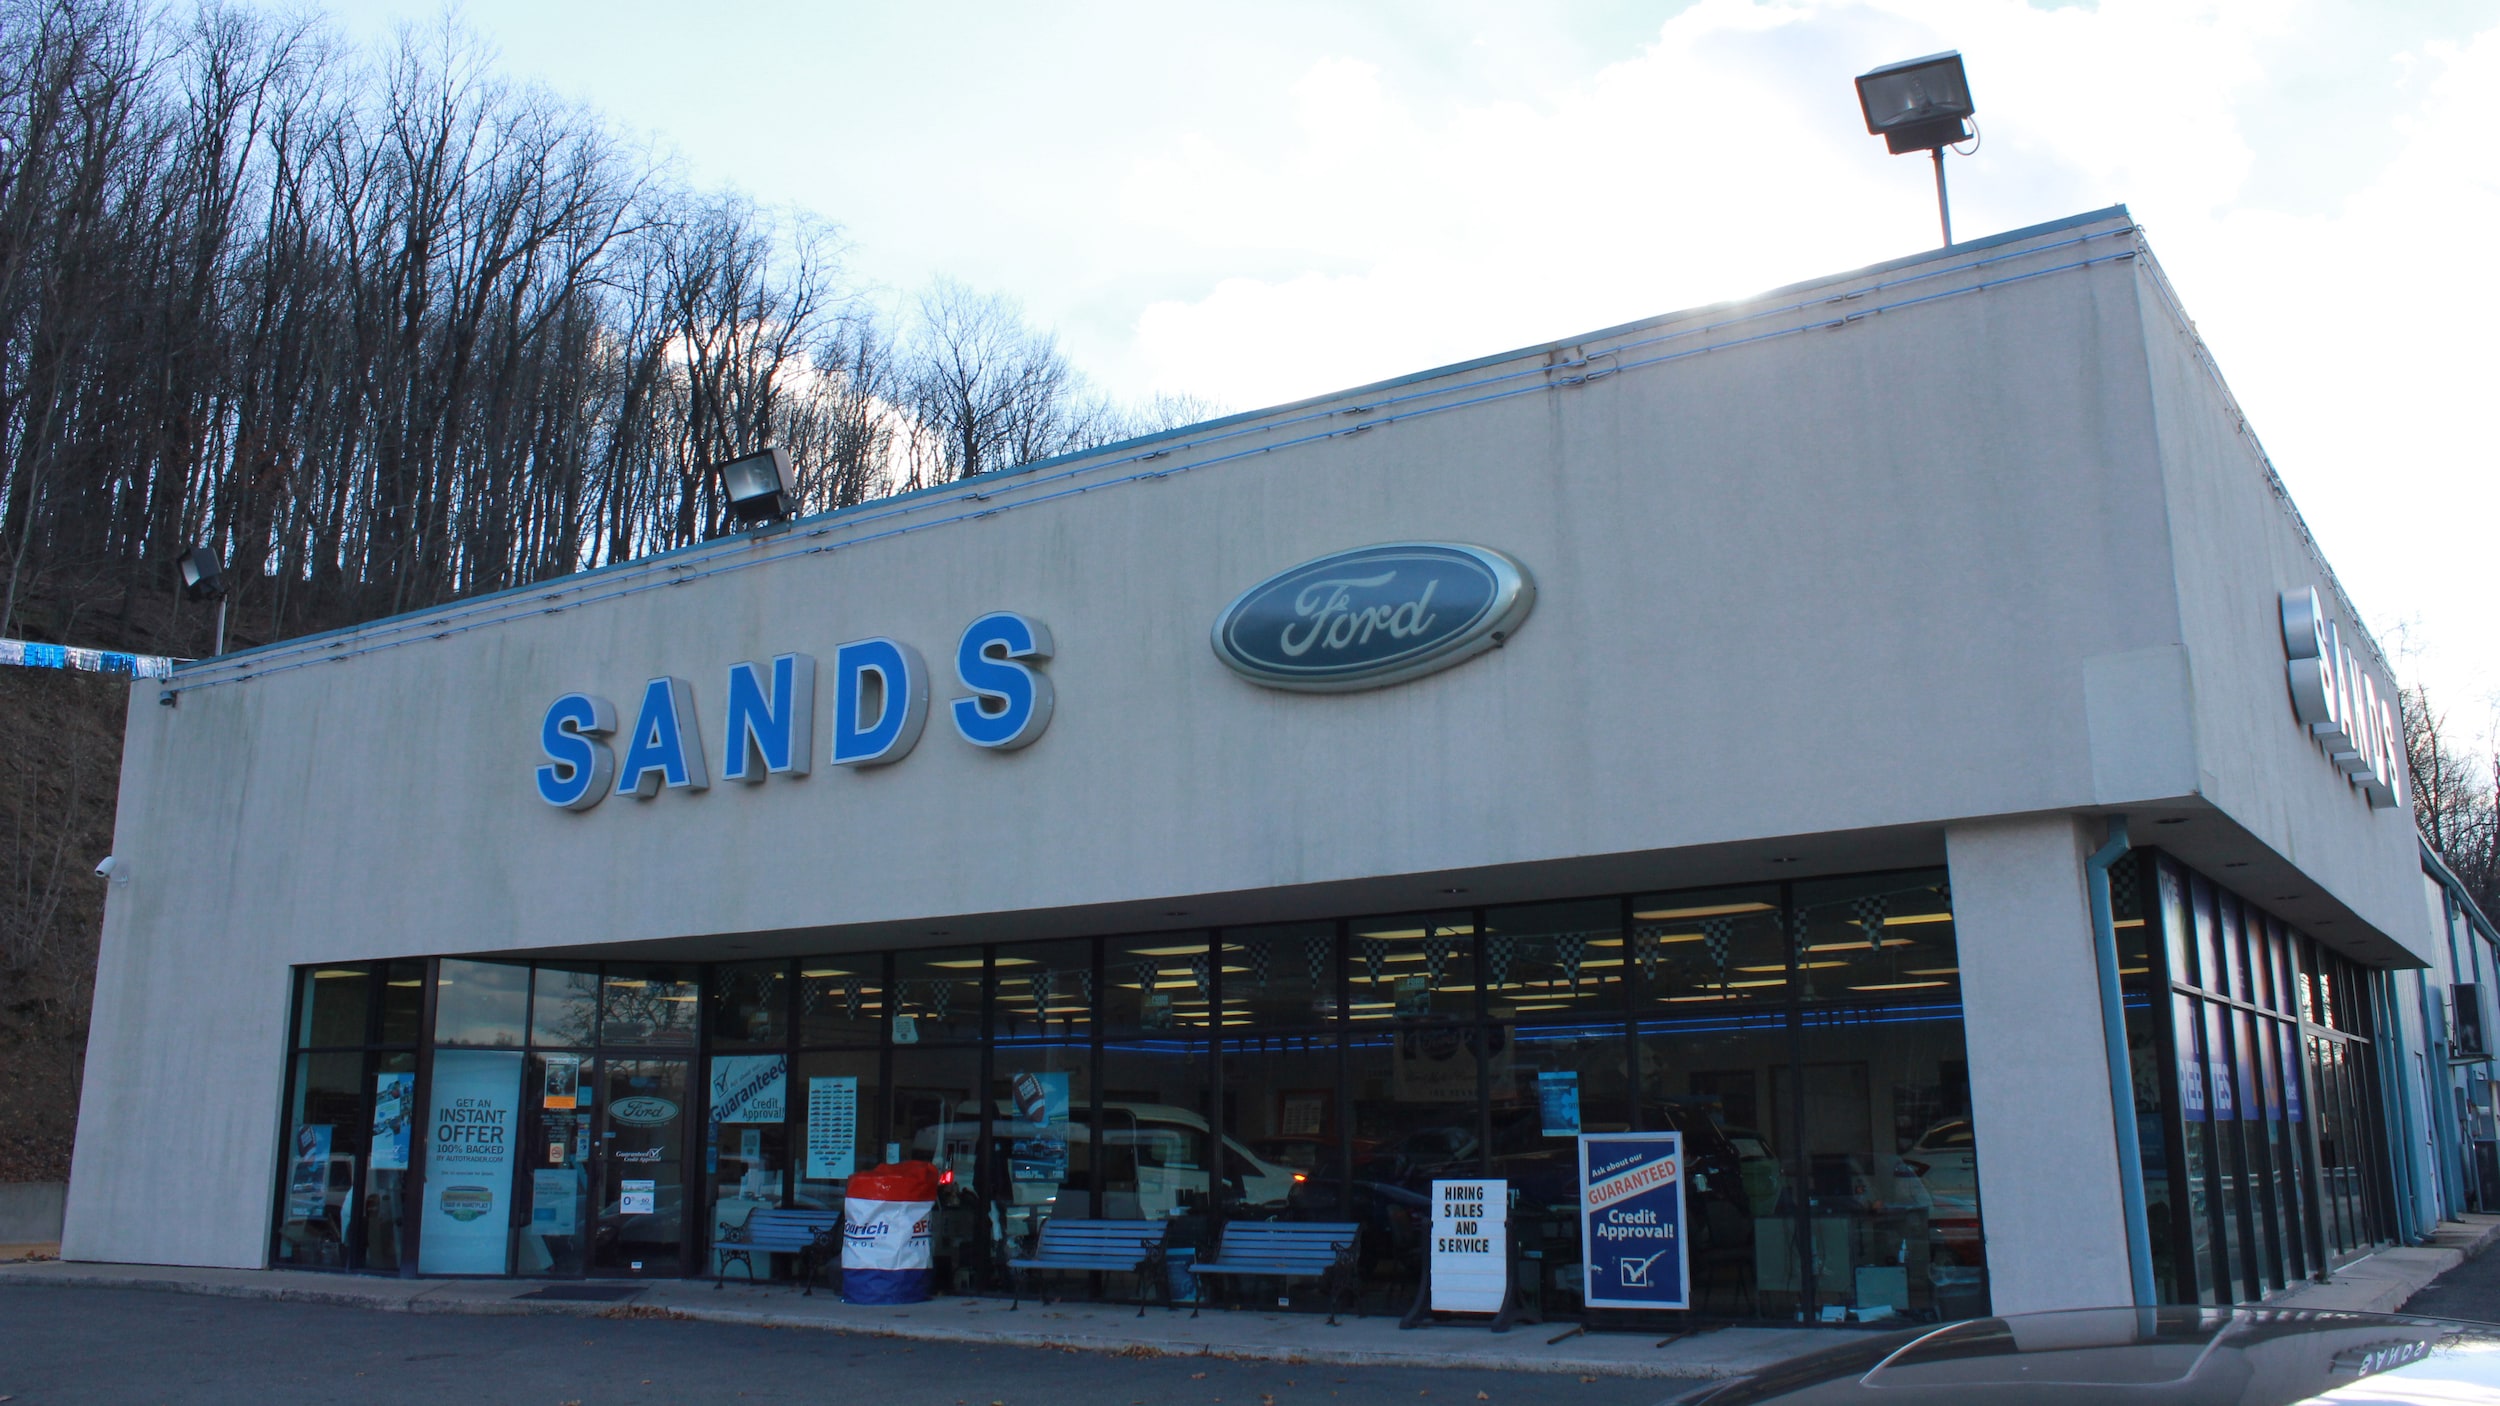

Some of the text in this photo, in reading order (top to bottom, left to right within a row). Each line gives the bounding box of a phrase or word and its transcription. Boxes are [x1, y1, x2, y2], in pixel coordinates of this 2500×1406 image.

[1281, 570, 1439, 656] Ford
[2294, 585, 2401, 809] SANDS
[536, 611, 1048, 809] SANDS
[711, 1054, 787, 1123] Guaranteed
[456, 1098, 491, 1108] GET AN
[623, 1101, 664, 1118] Ford
[752, 1098, 779, 1110] Credit
[439, 1108, 507, 1124] INSTANT
[742, 1107, 785, 1121] Approval!
[437, 1124, 504, 1144] OFFER
[437, 1144, 504, 1155] 100% BACKED
[446, 1155, 504, 1163] AUTOTRADER.COM
[1592, 1153, 1643, 1178] Ask about our
[1588, 1160, 1676, 1205] GUARANTEED
[1445, 1186, 1483, 1200] HIRING
[1444, 1203, 1483, 1218] SALES
[1608, 1209, 1656, 1225] Credit
[1455, 1221, 1477, 1235] AND
[1597, 1223, 1674, 1241] Approval!
[1438, 1238, 1489, 1253] SERVICE
